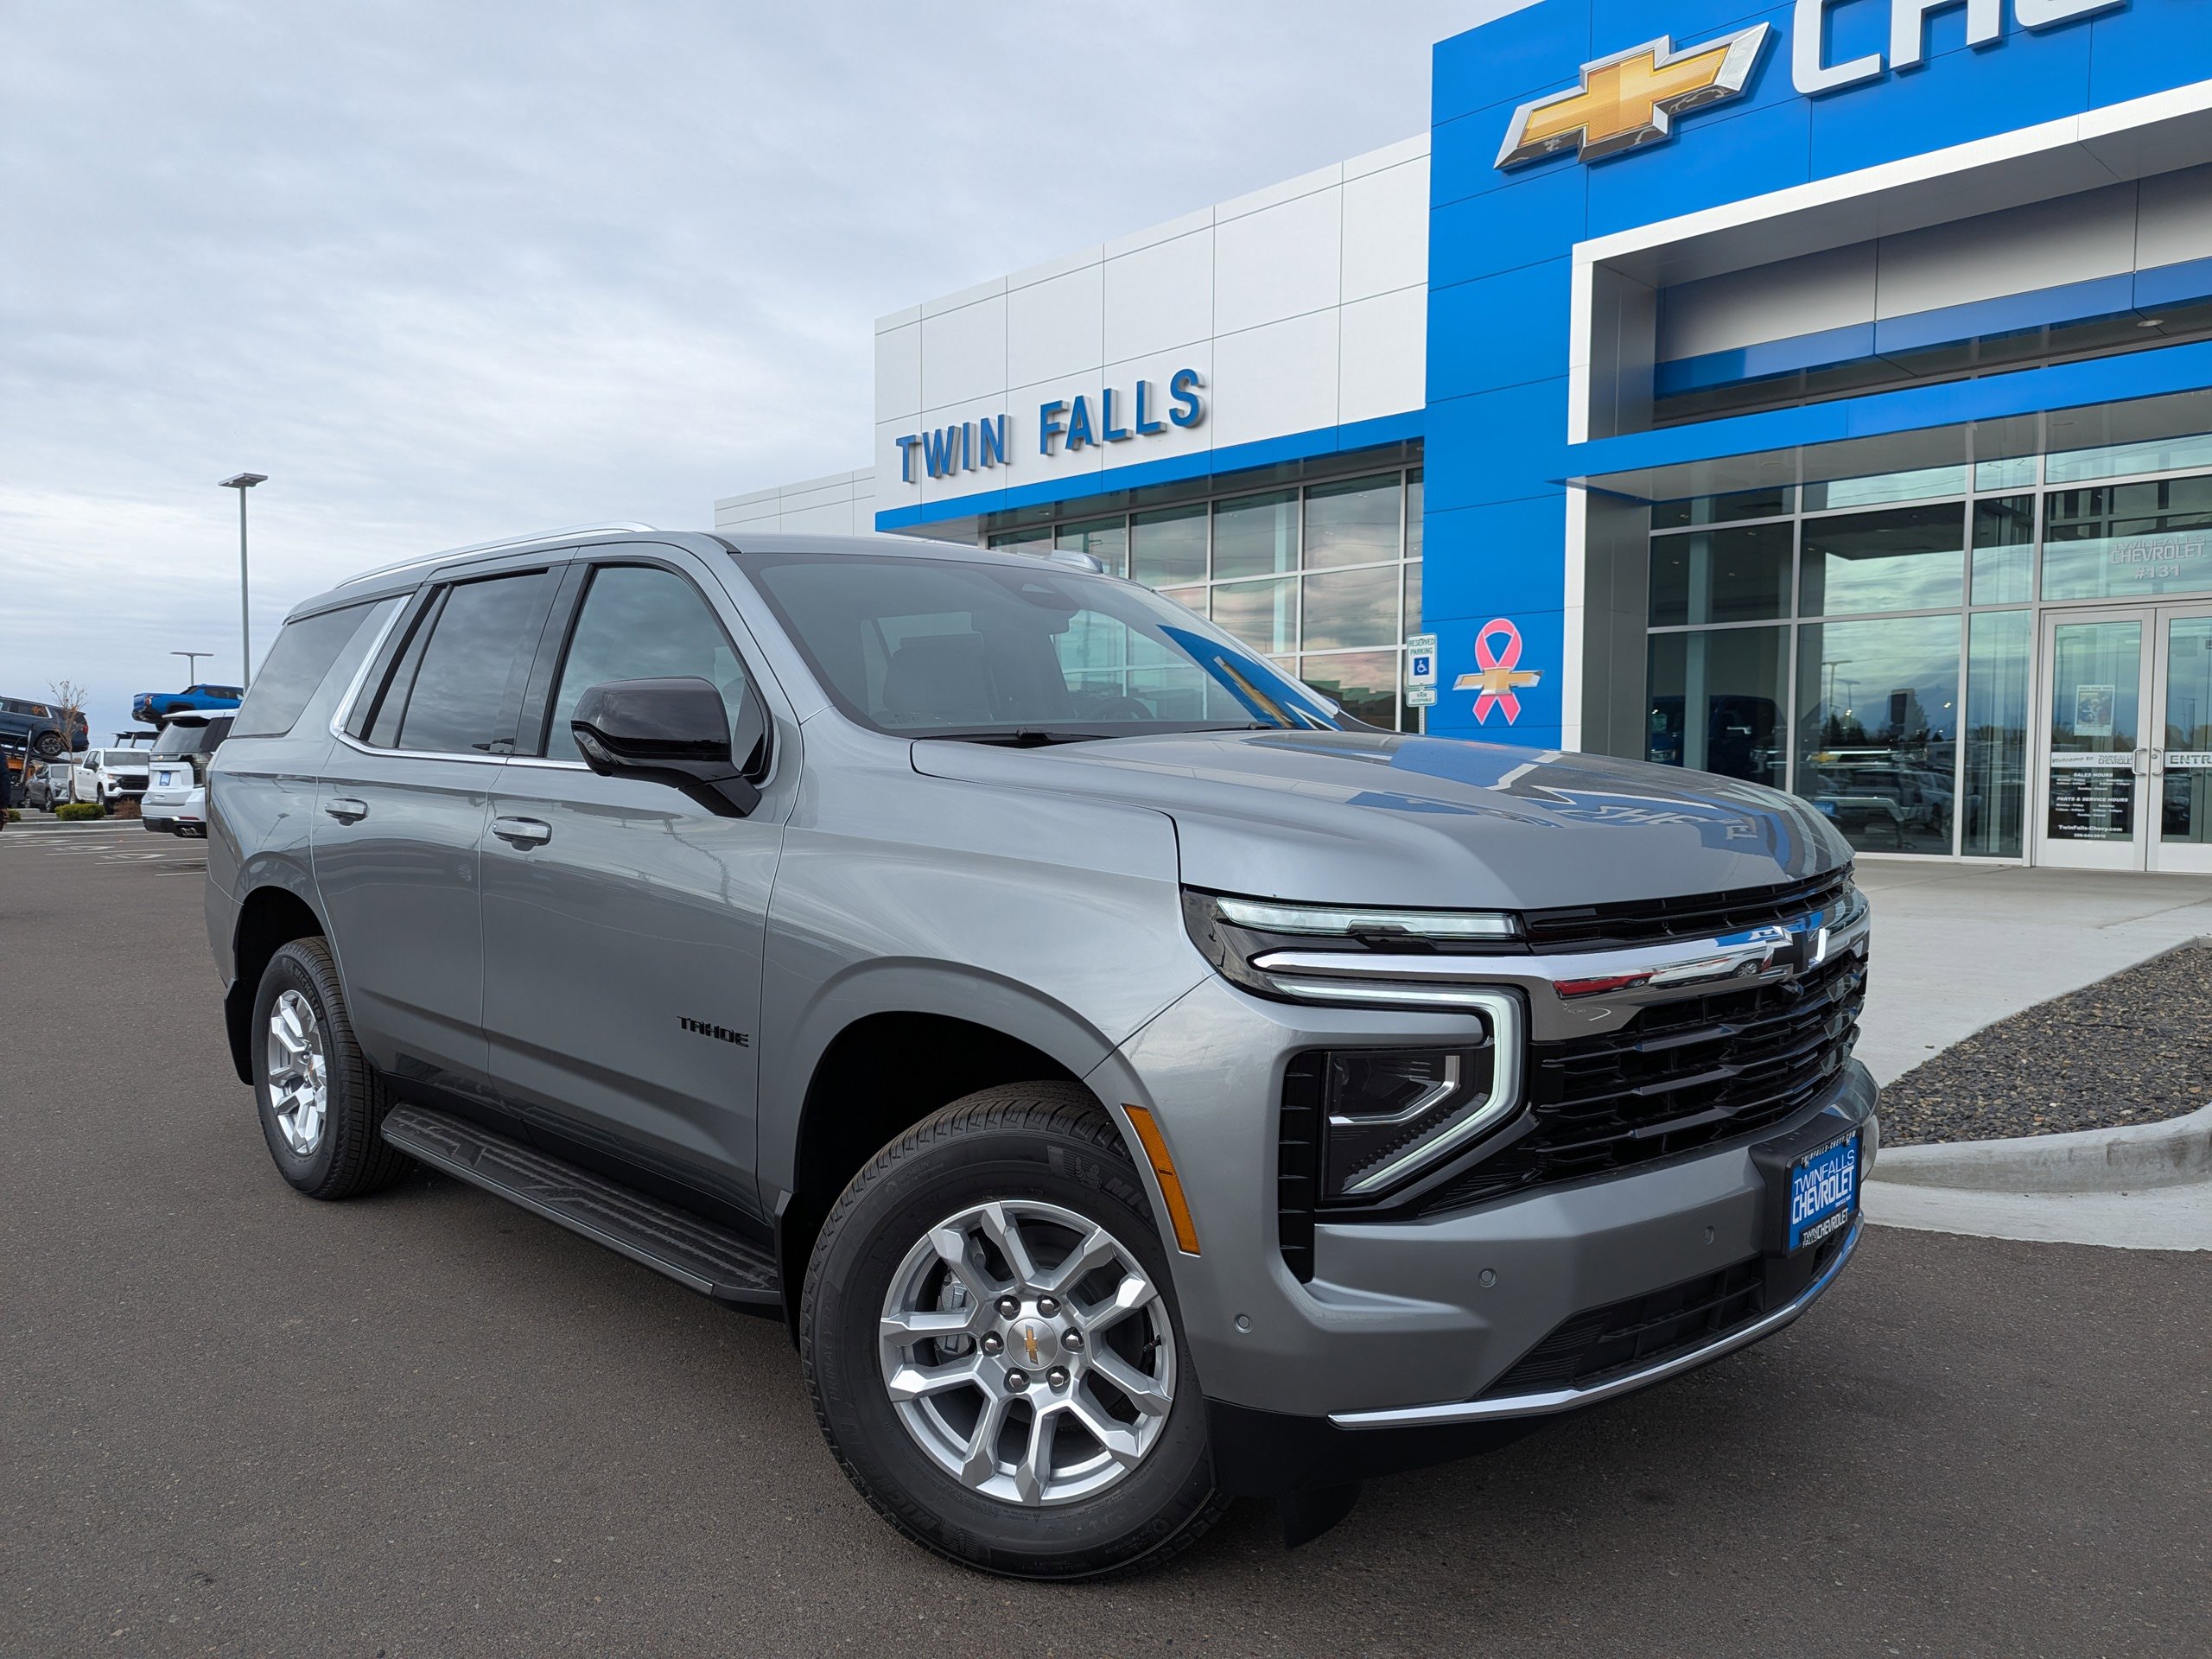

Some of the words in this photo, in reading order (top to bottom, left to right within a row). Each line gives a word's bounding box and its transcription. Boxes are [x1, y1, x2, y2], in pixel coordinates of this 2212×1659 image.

[1792, 0, 2127, 96] CH
[896, 414, 1010, 483] TWIN
[1040, 368, 1205, 457] FALLS
[2111, 543, 2206, 564] CHEVROLET
[2135, 564, 2181, 579] #131
[677, 1015, 749, 1048] TAHOE
[1794, 1149, 1855, 1196] TWINFALLS
[1104, 1177, 1155, 1225] MIC
[1792, 1165, 1855, 1225] CHEVROLET
[1802, 1227, 1818, 1239] TWIN
[1817, 1208, 1849, 1239] CHEVROLET
